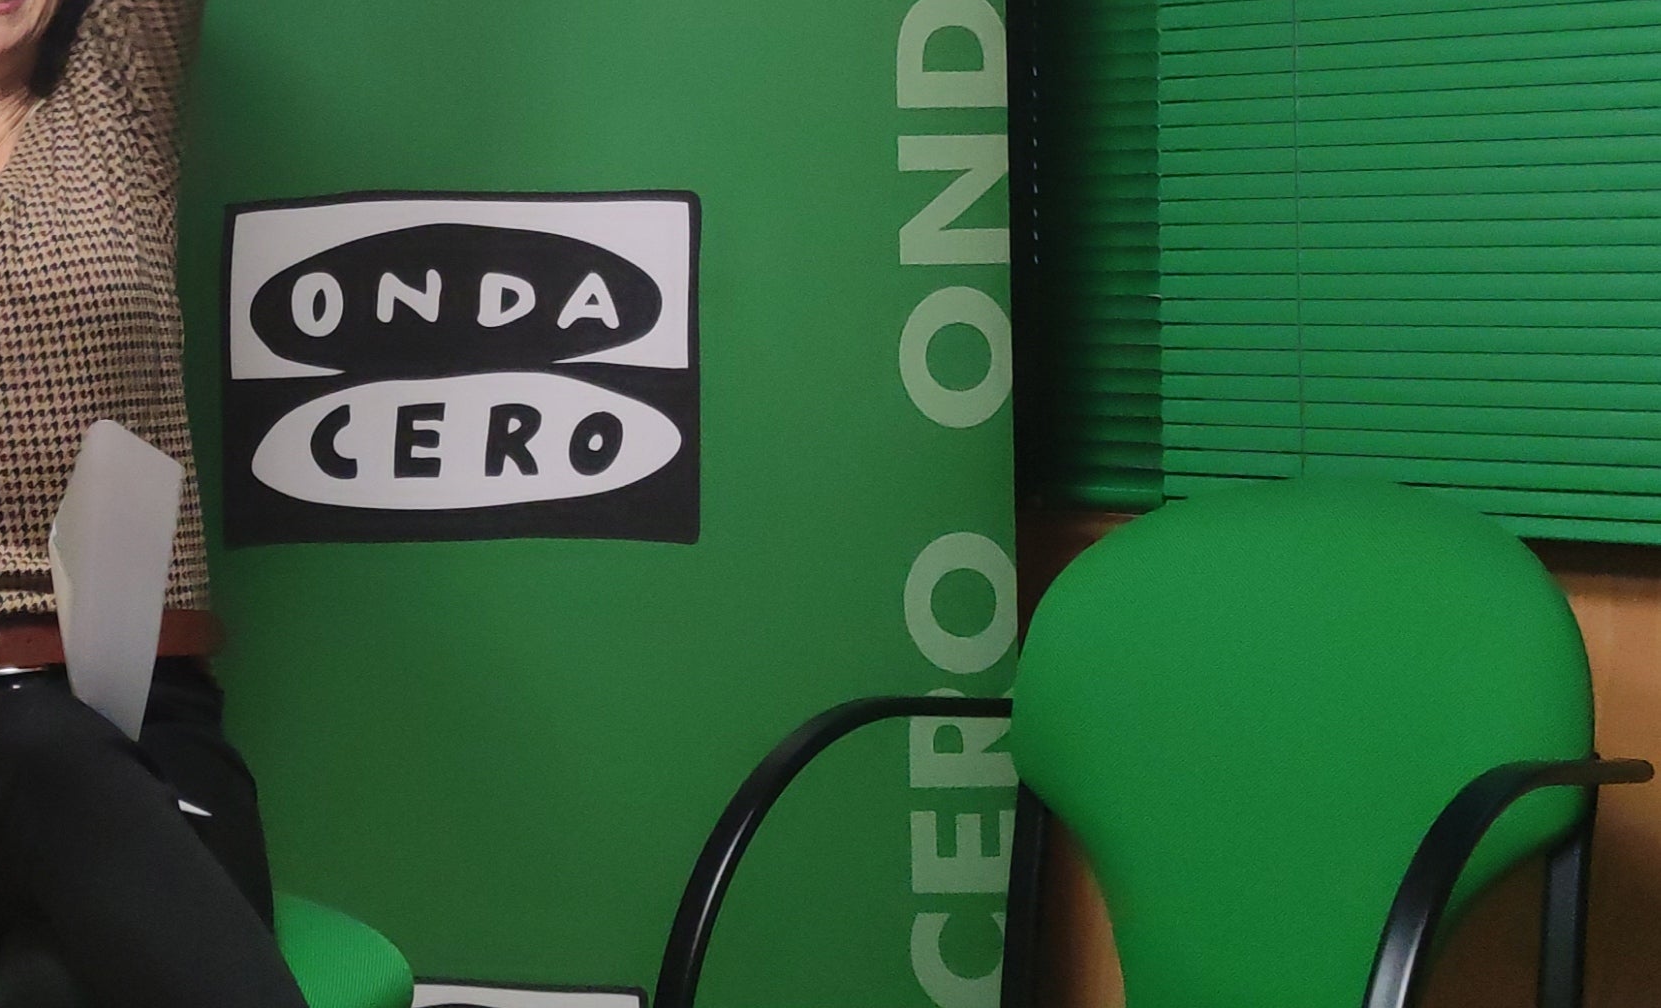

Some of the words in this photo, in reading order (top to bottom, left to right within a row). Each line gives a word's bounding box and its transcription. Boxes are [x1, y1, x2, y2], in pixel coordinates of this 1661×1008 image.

[291, 268, 620, 337] ONDA
[310, 403, 624, 479] CERO
[904, 531, 1018, 1008] CERO
